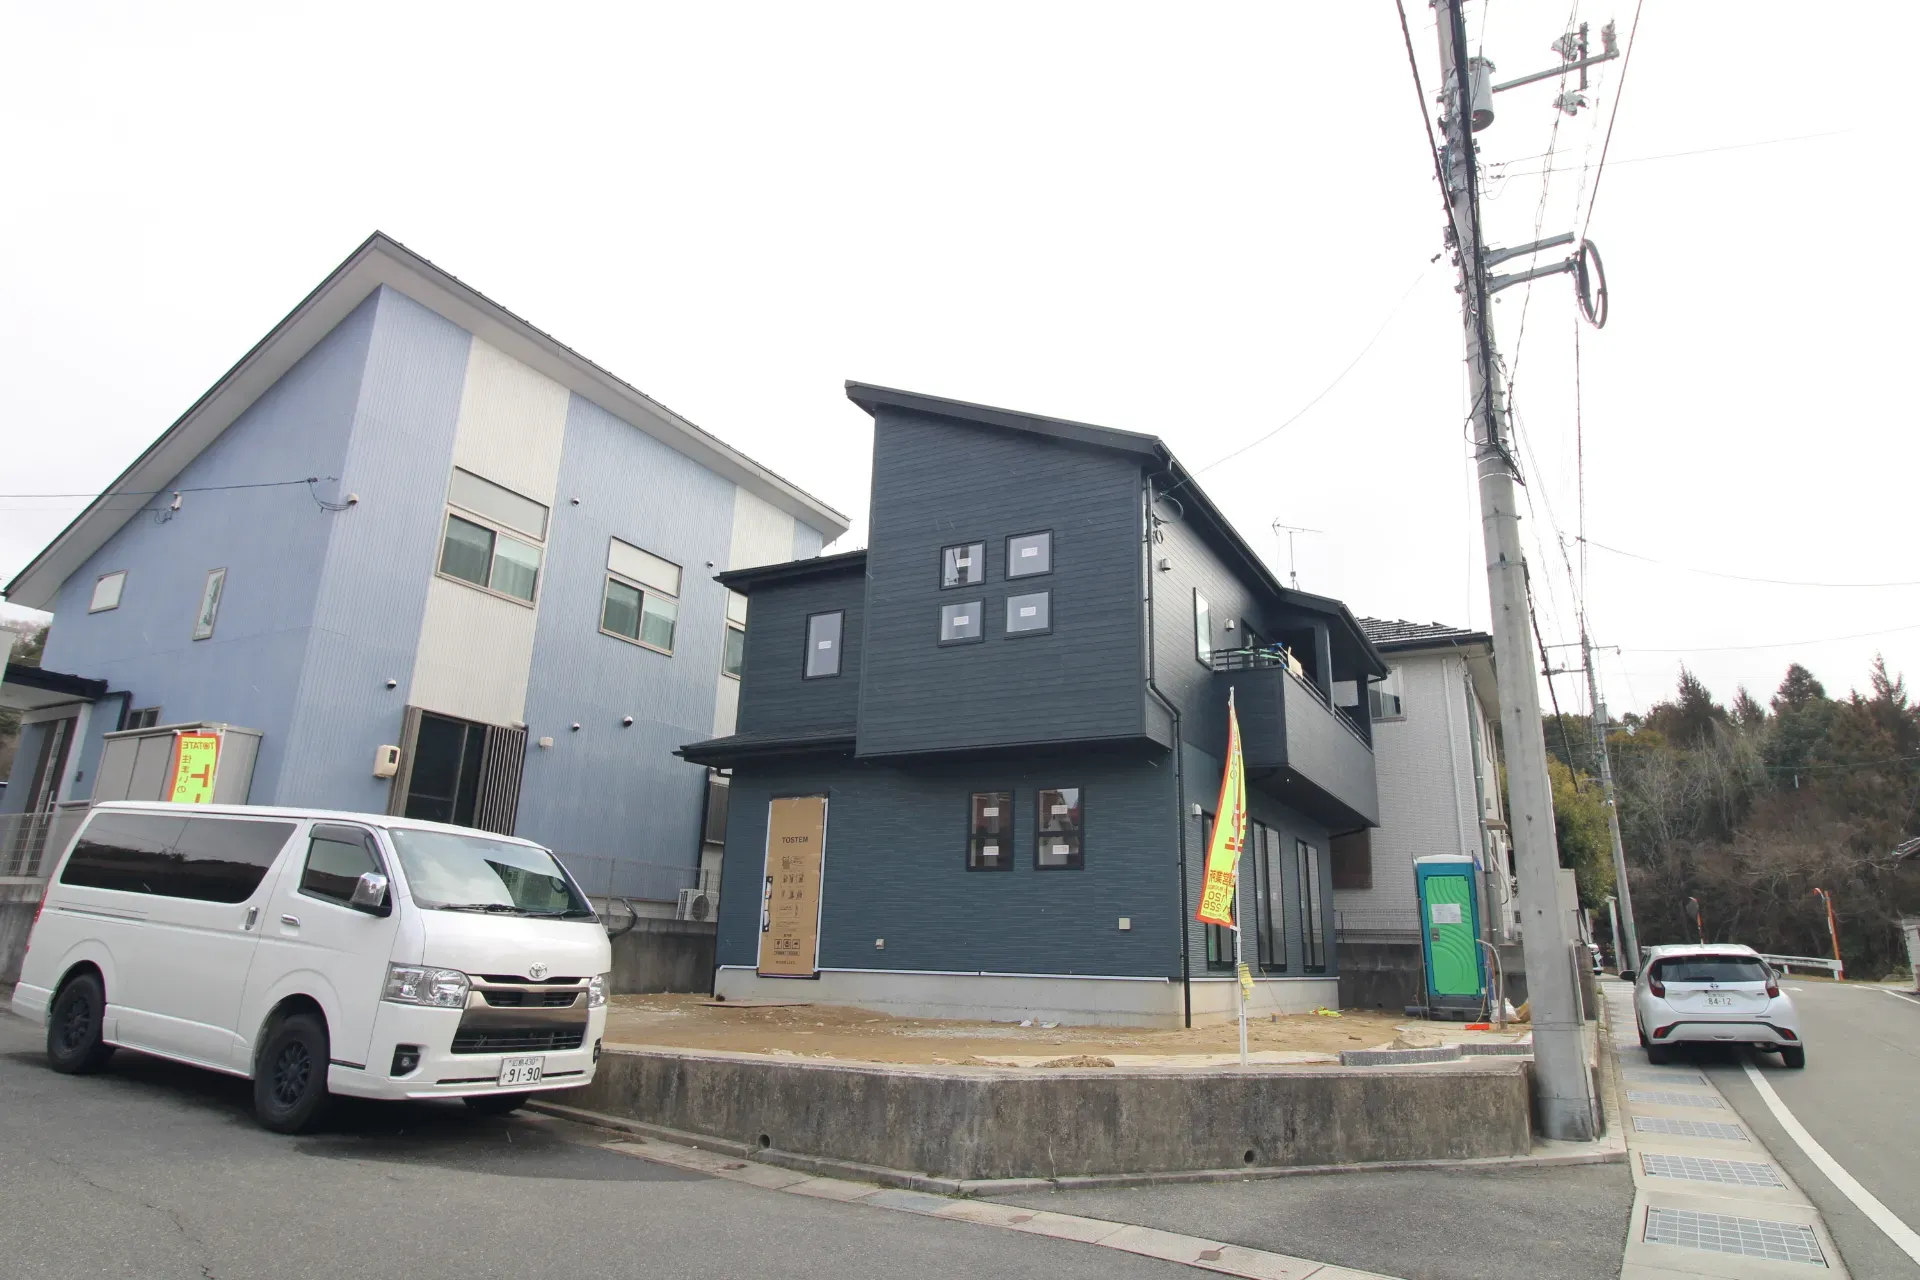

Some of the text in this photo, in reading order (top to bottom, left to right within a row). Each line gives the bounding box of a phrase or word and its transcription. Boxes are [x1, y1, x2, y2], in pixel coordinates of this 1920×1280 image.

[782, 836, 809, 844] TOSTEM
[1708, 997, 1732, 1005] 84-12
[508, 1067, 541, 1082] 91-90
